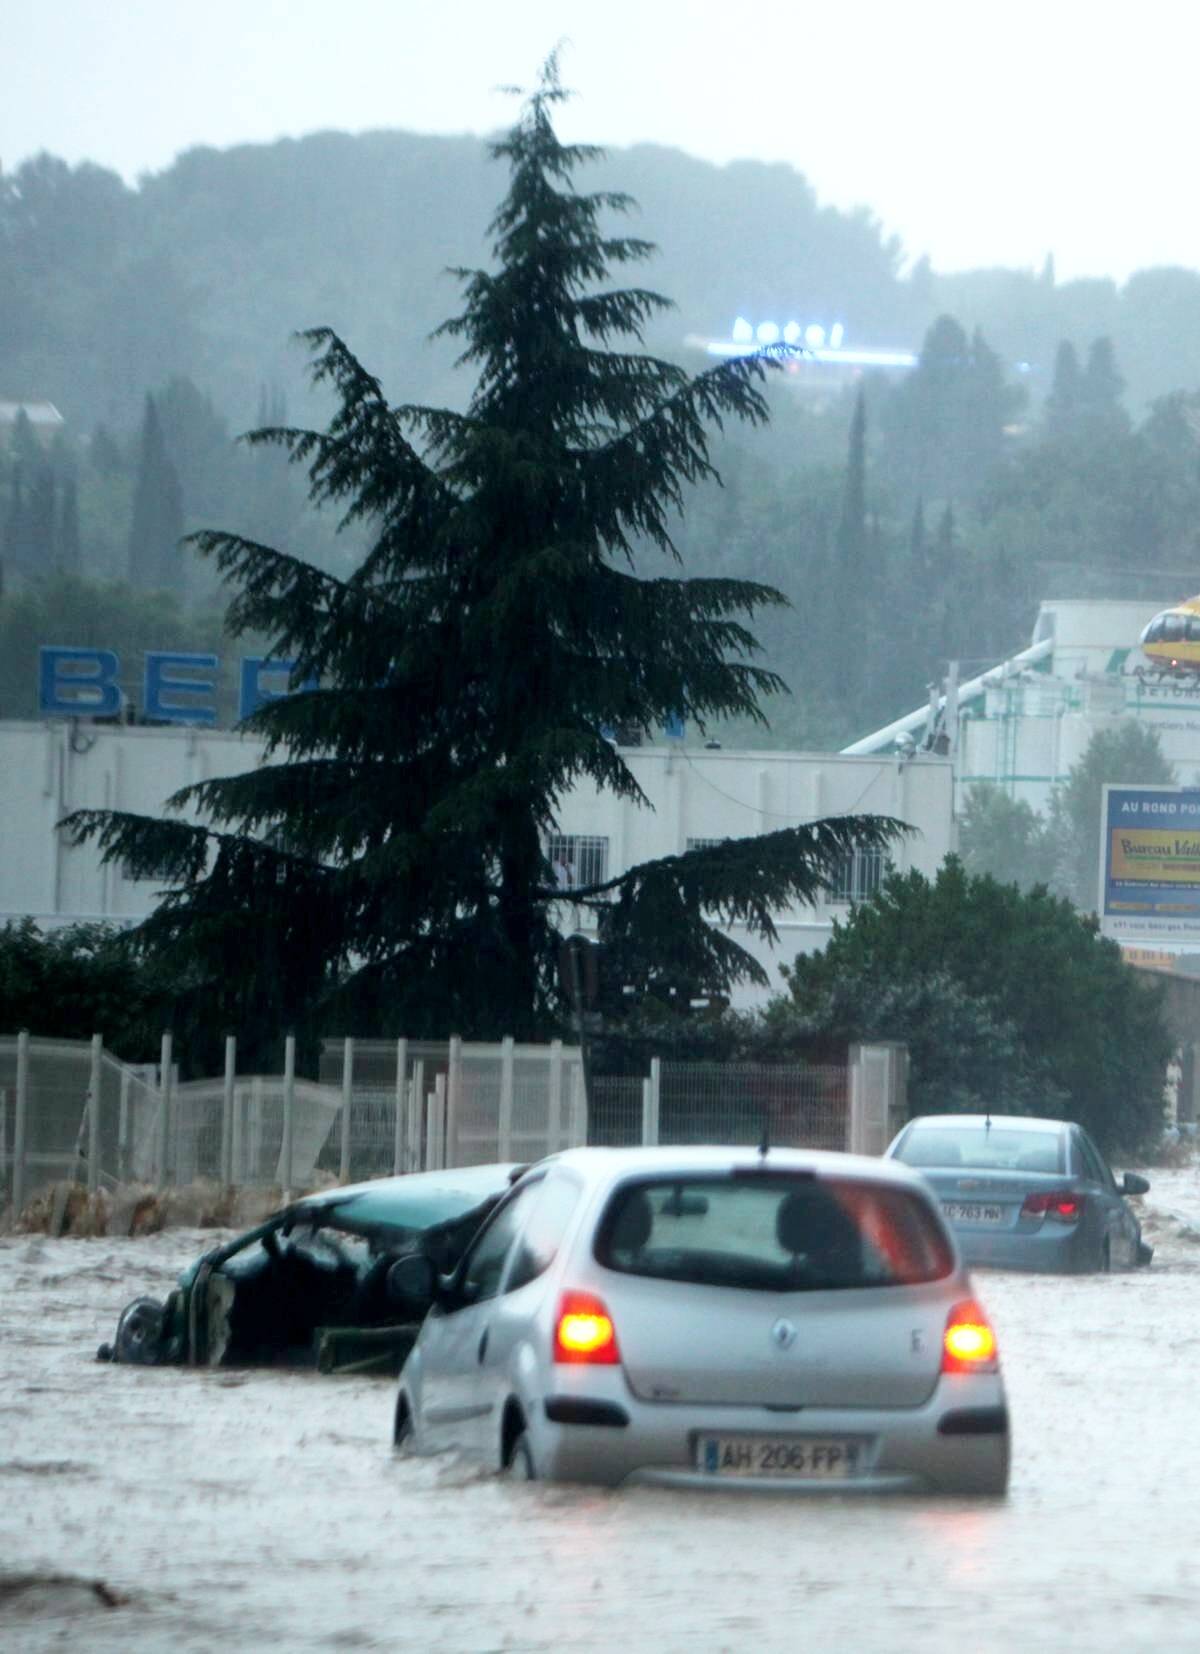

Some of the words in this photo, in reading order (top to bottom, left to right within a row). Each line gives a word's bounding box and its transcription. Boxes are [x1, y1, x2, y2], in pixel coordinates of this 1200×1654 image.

[1121, 802, 1139, 813] AU
[1142, 803, 1177, 815] ROND
[1121, 839, 1171, 857] Bureau
[722, 1444, 751, 1468] AH
[760, 1444, 805, 1469] 206
